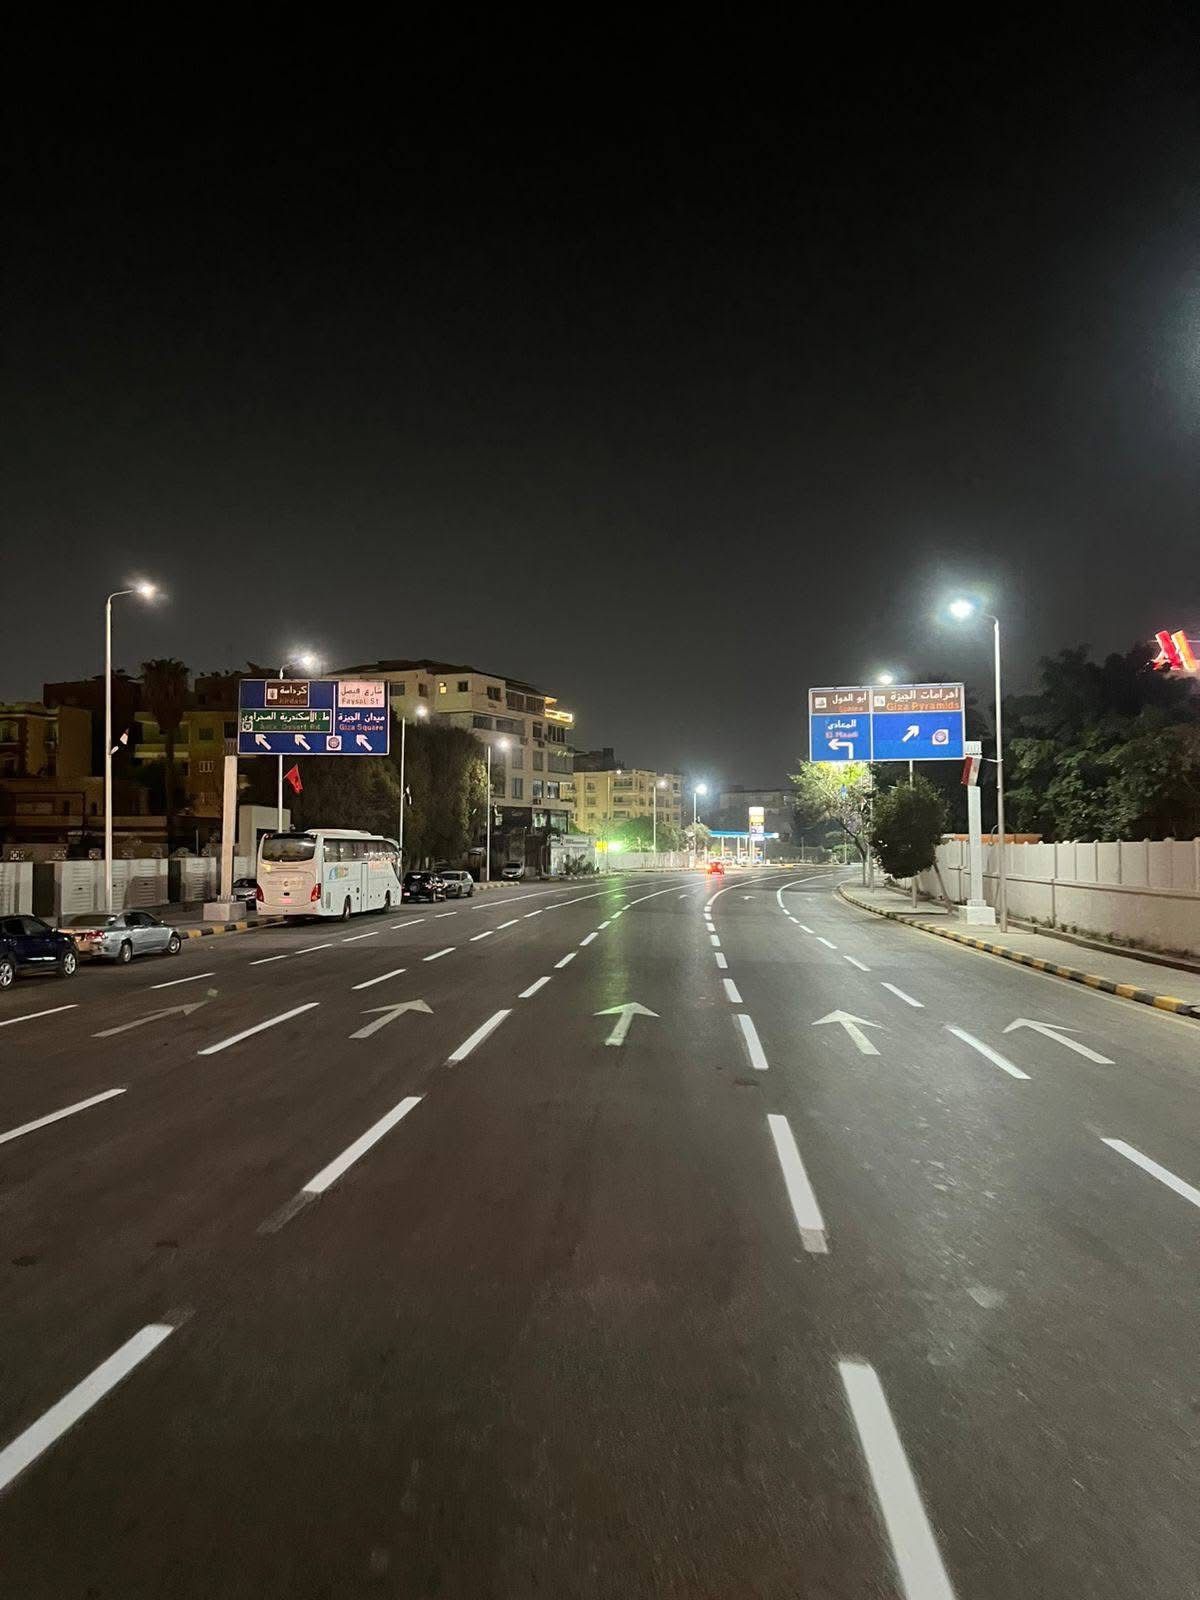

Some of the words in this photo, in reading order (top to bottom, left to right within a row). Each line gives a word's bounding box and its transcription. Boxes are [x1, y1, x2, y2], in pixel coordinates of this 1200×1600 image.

[890, 689, 916, 702] الجيزة
[886, 702, 909, 711] Giza
[912, 701, 960, 711] Pyramids
[338, 712, 361, 723] الجيزة
[364, 712, 385, 723] ميدان
[339, 723, 356, 731] Giza
[357, 723, 384, 732] Square
